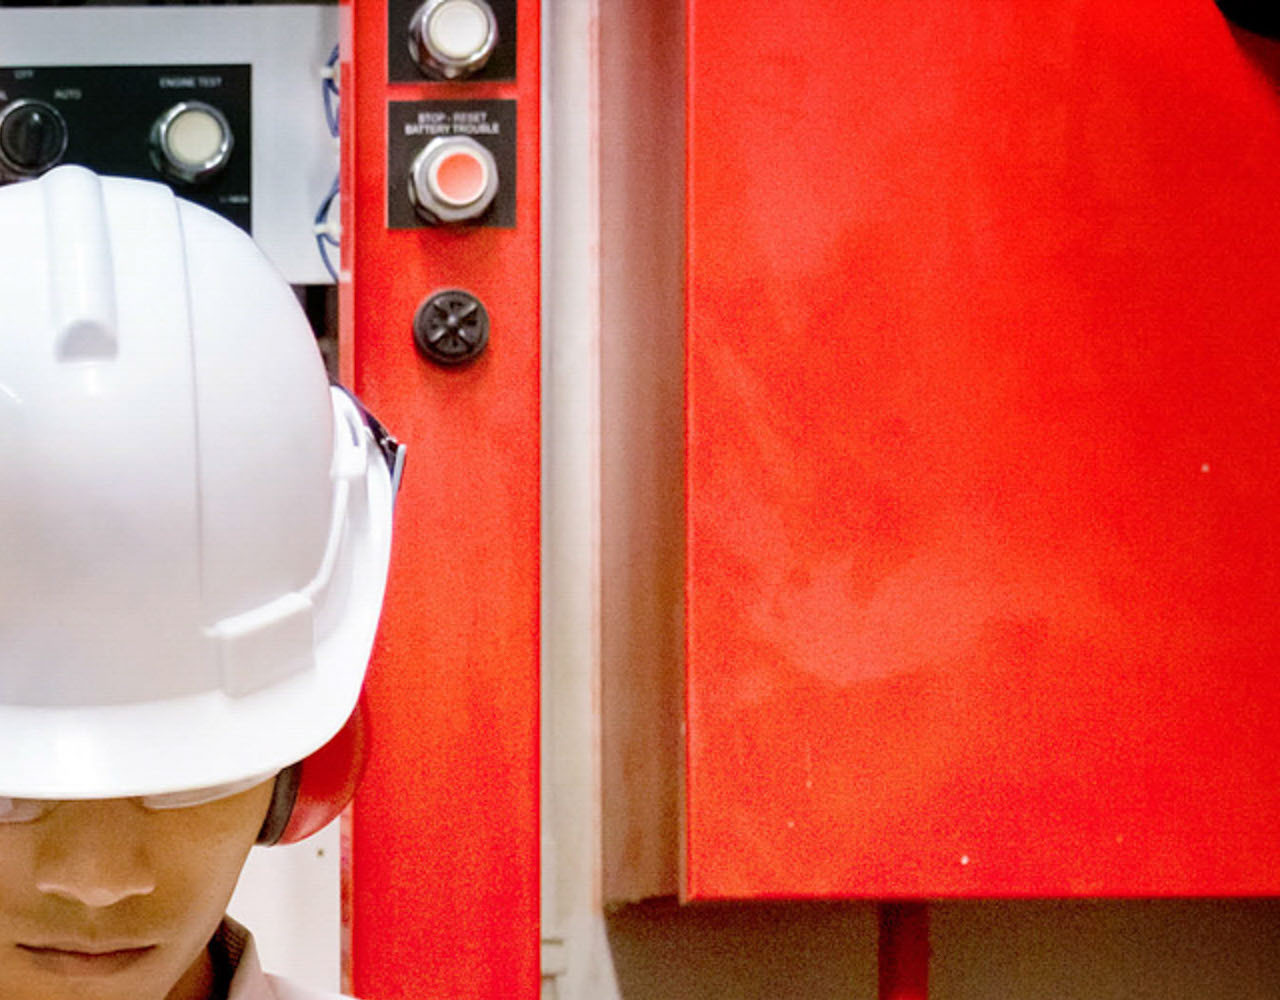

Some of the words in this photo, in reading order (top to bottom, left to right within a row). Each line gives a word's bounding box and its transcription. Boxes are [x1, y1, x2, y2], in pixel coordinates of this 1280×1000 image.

[159, 77, 195, 88] ENGINE
[198, 76, 222, 87] TEST
[54, 89, 82, 99] AUTO
[417, 111, 445, 122] STOP
[453, 111, 487, 122] RESET
[404, 123, 451, 135] BATTERY
[453, 122, 499, 134] TROUBLE
